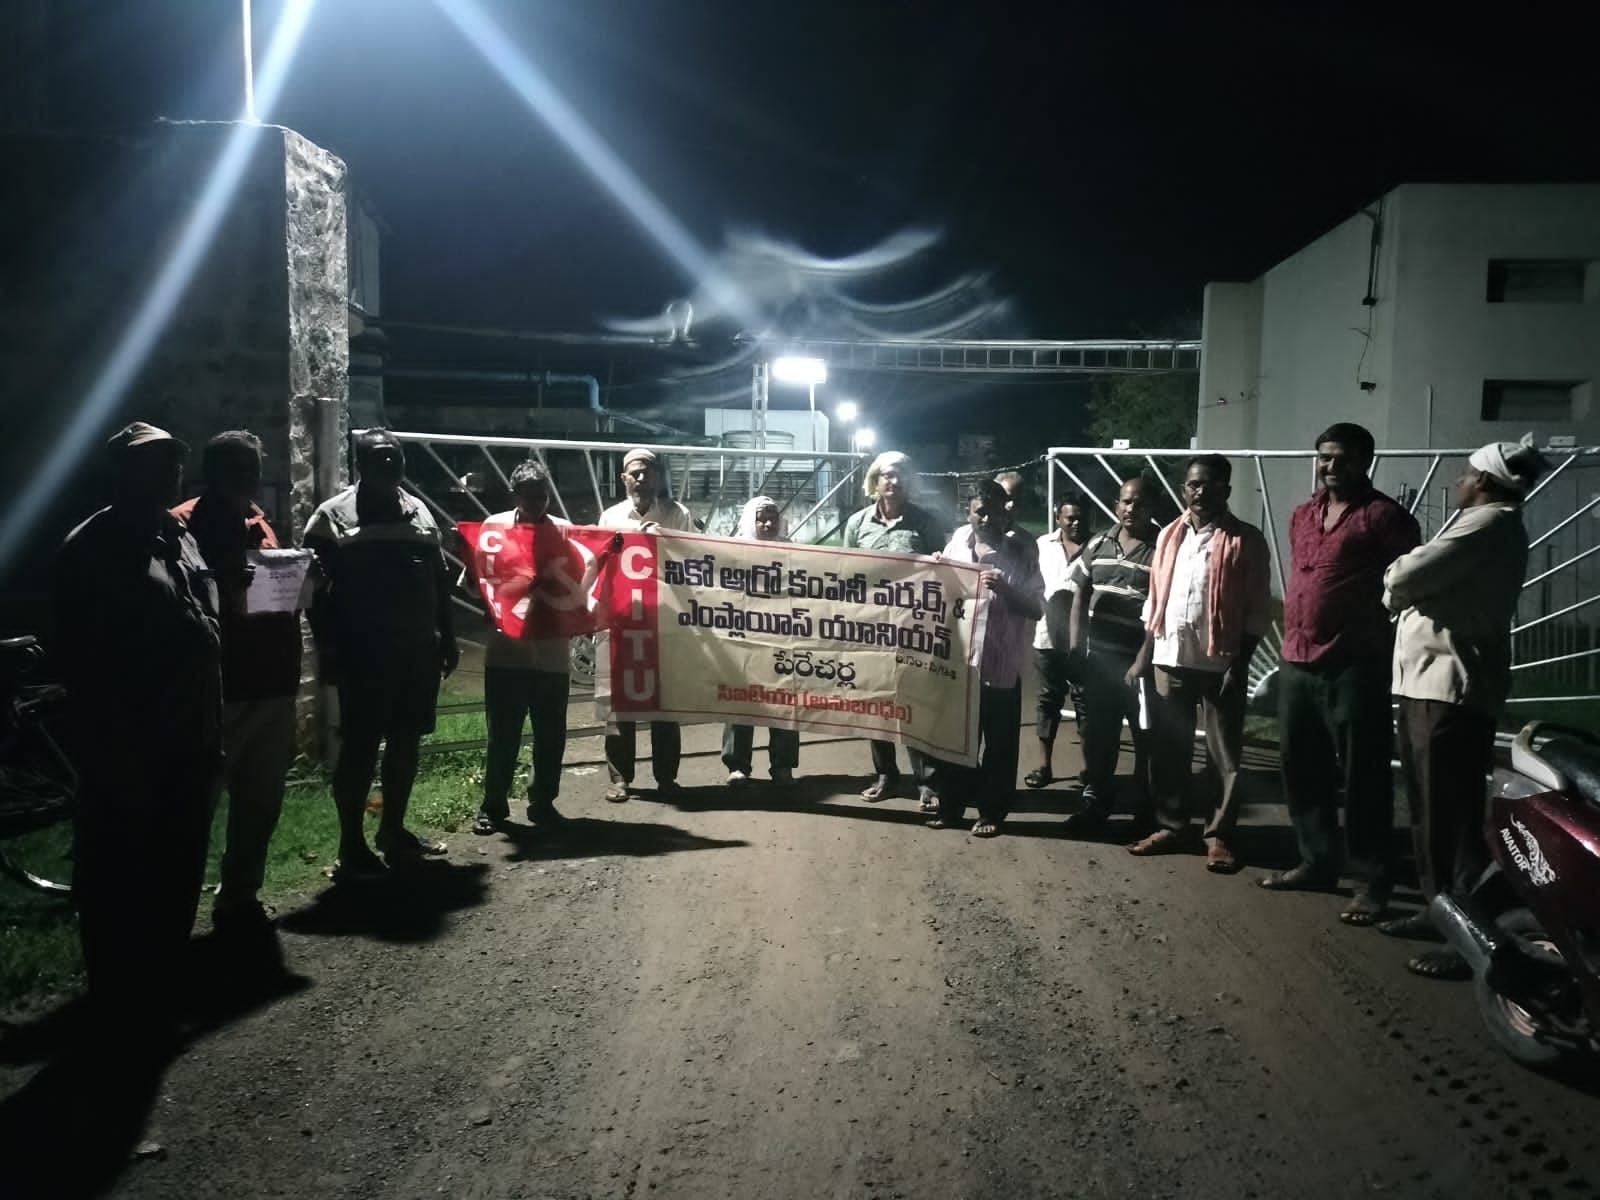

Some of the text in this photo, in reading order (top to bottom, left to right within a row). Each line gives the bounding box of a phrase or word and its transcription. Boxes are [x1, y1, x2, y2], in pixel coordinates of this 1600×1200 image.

[664, 554, 966, 624] నికో ఆగ్రో కంపెనీ వర్కర్స్ &
[620, 545, 655, 701] CITU
[678, 599, 952, 660] ఎంప్లాయీస్ యూనియన్
[773, 650, 857, 690] పేరేచర్ల
